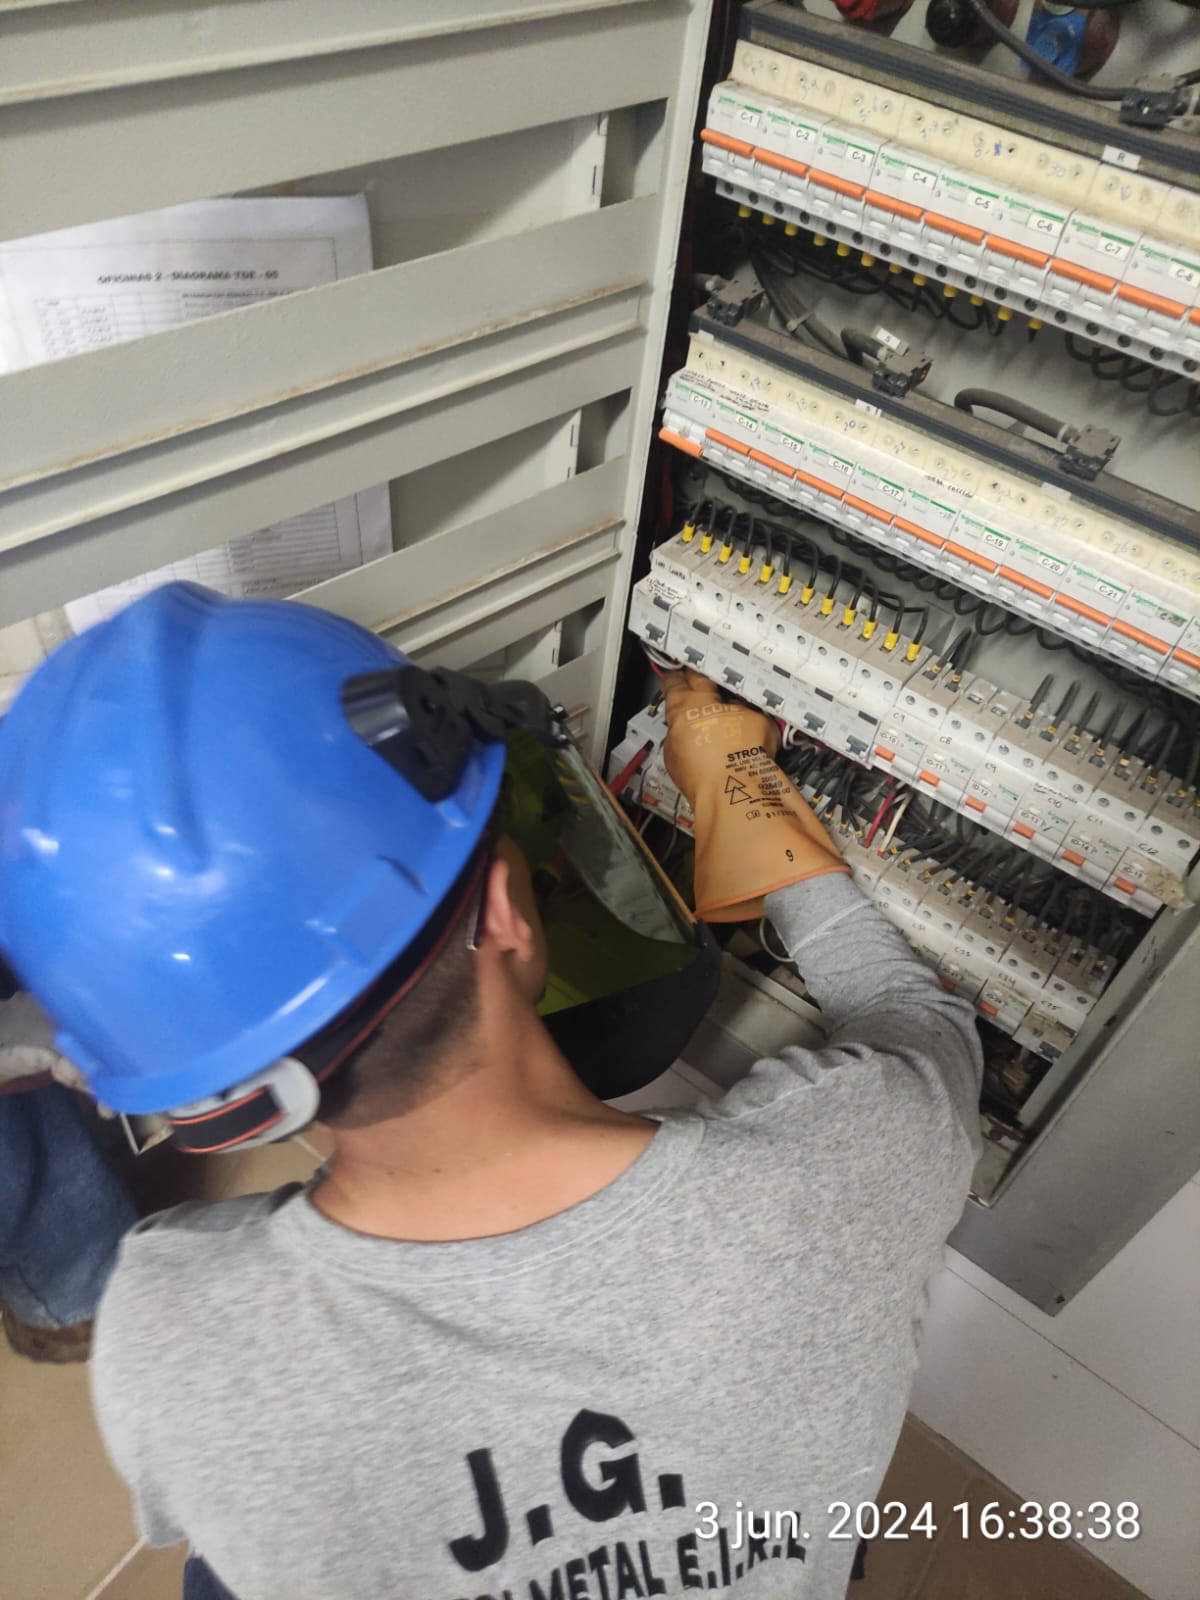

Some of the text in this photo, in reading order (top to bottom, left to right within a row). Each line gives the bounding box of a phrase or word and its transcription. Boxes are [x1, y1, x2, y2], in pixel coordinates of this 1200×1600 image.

[740, 112, 753, 123] C-1
[796, 130, 810, 142] C-2
[851, 152, 866, 163] C-3
[912, 172, 928, 185] C-4
[974, 197, 990, 209] C-5
[1104, 243, 1121, 255] C-7
[882, 485, 899, 498] C-17
[985, 534, 1003, 547] C-19
[1099, 585, 1117, 599] C-21
[785, 849, 794, 862] 9
